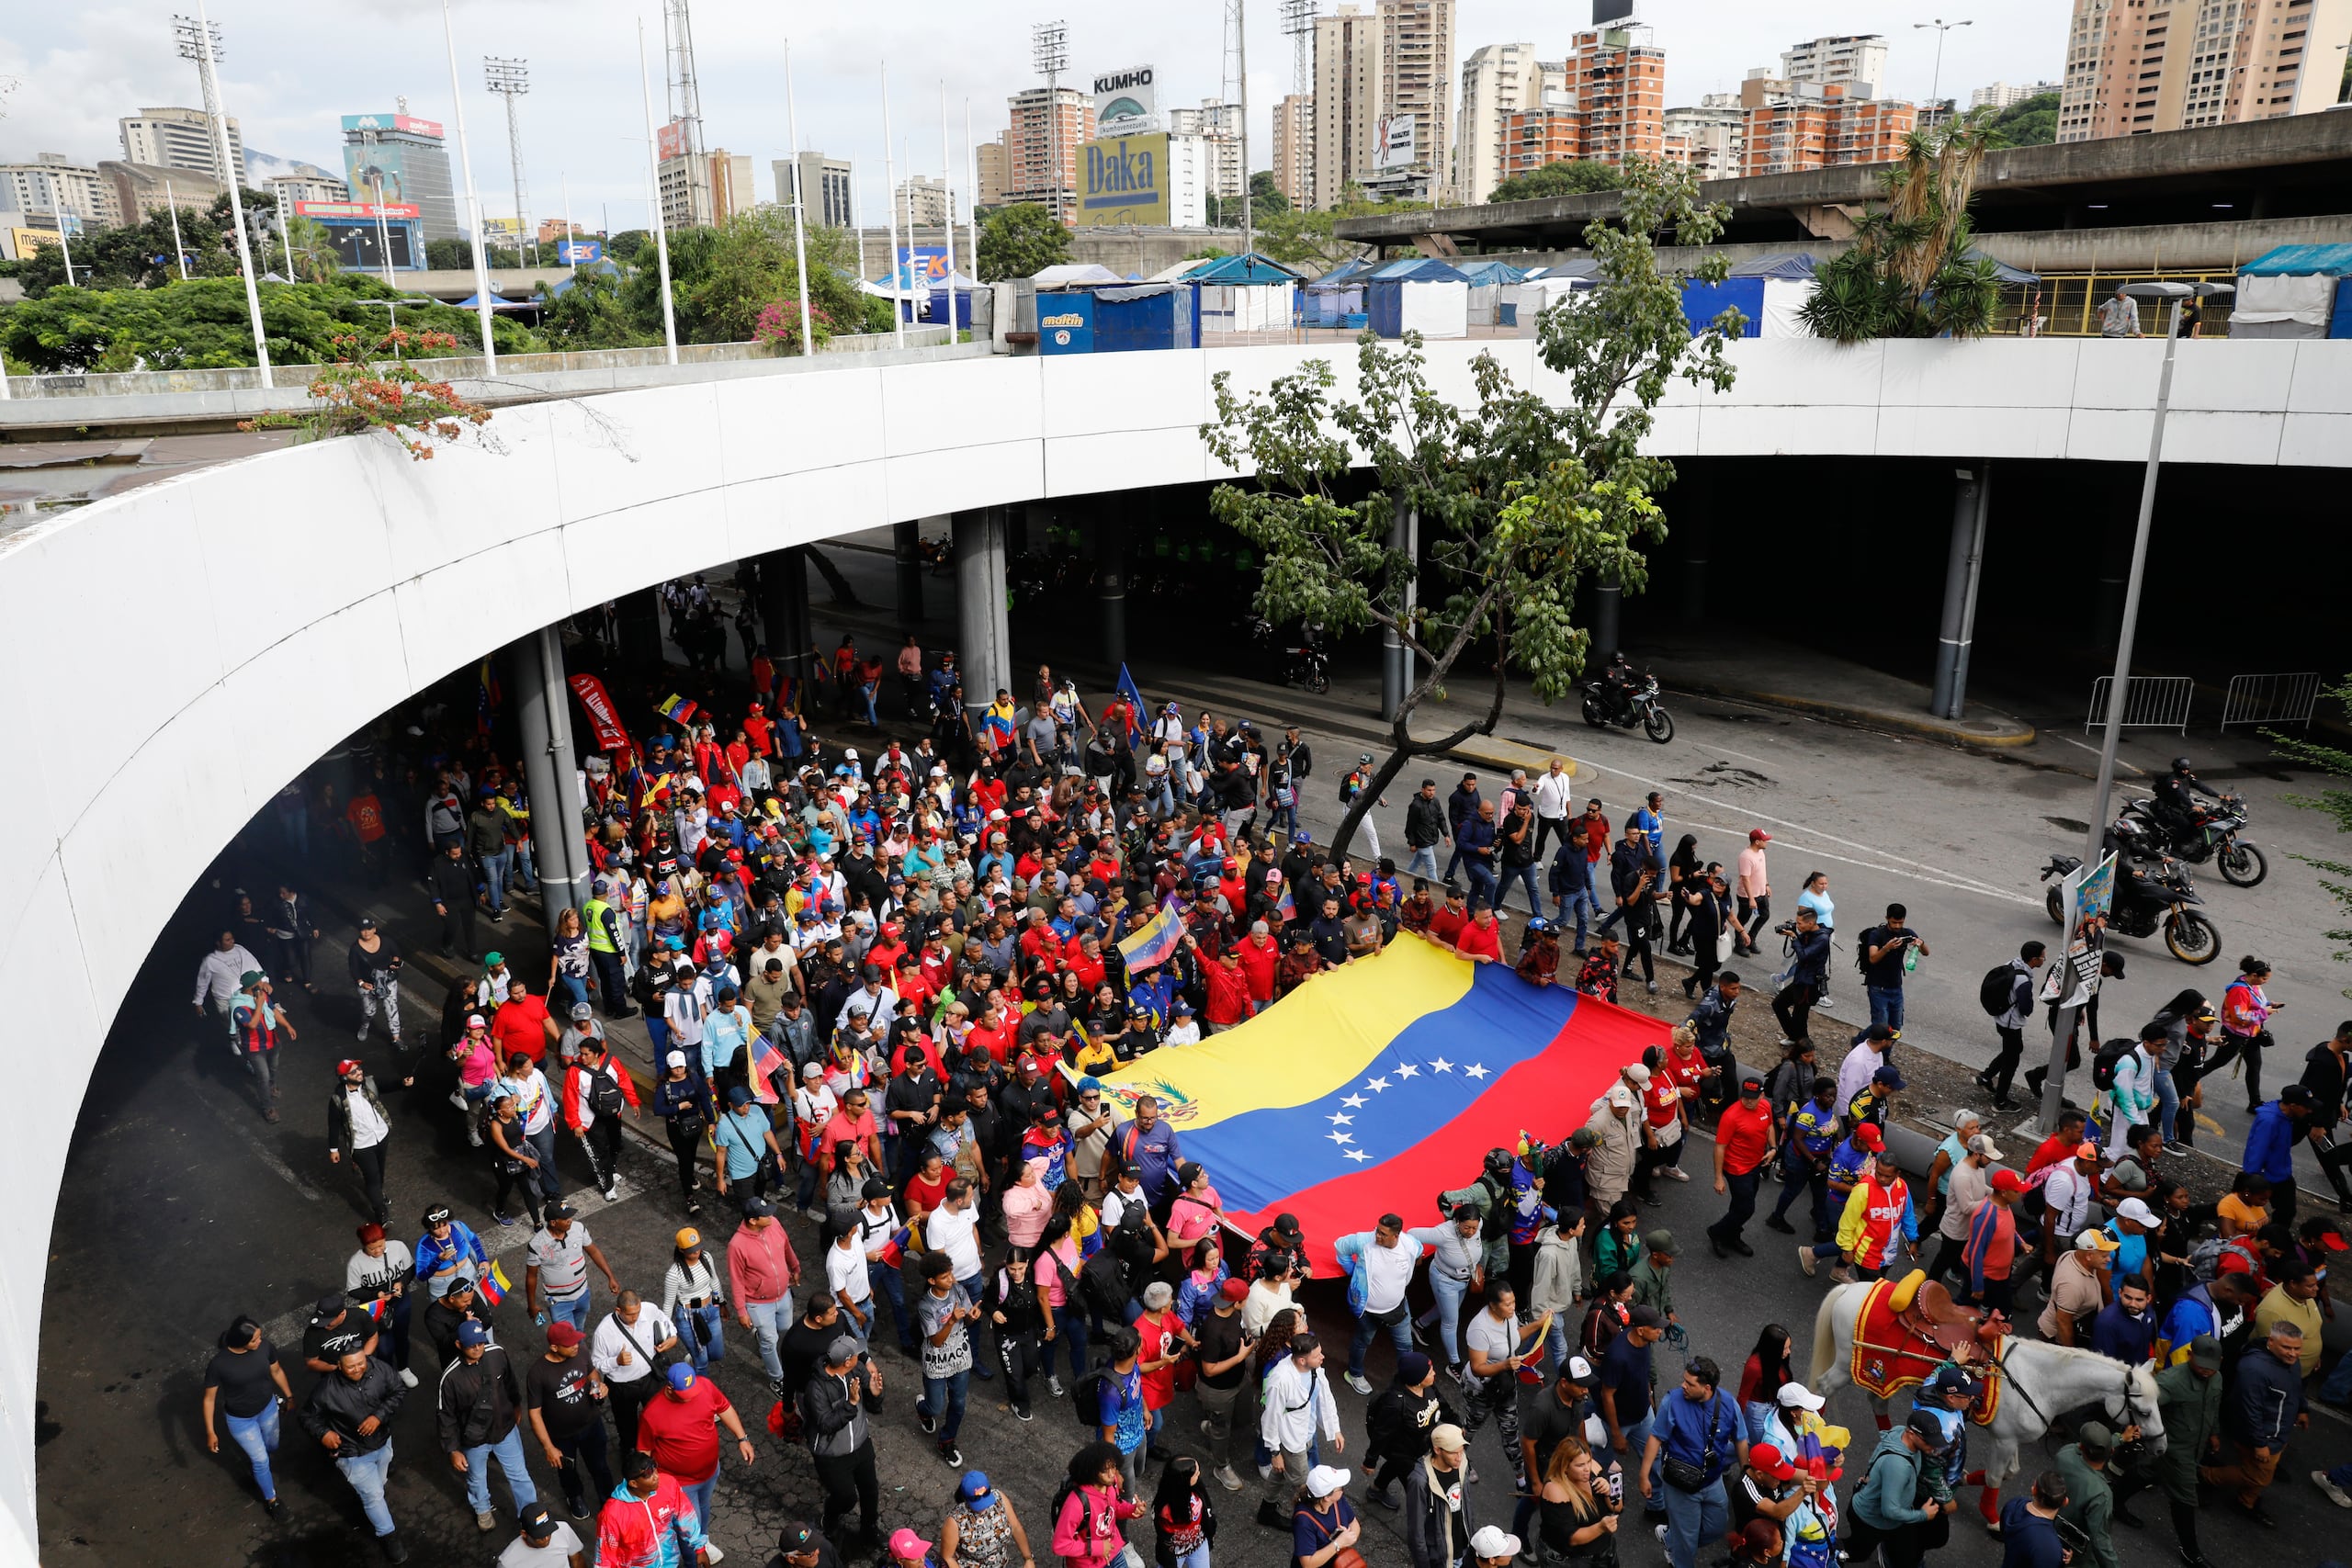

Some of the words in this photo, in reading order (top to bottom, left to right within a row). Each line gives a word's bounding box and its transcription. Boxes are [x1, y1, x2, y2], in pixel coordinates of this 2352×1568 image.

[1094, 70, 1152, 94] KUMHO
[1085, 141, 1153, 194] Daka
[560, 1370, 583, 1387] TOMMY
